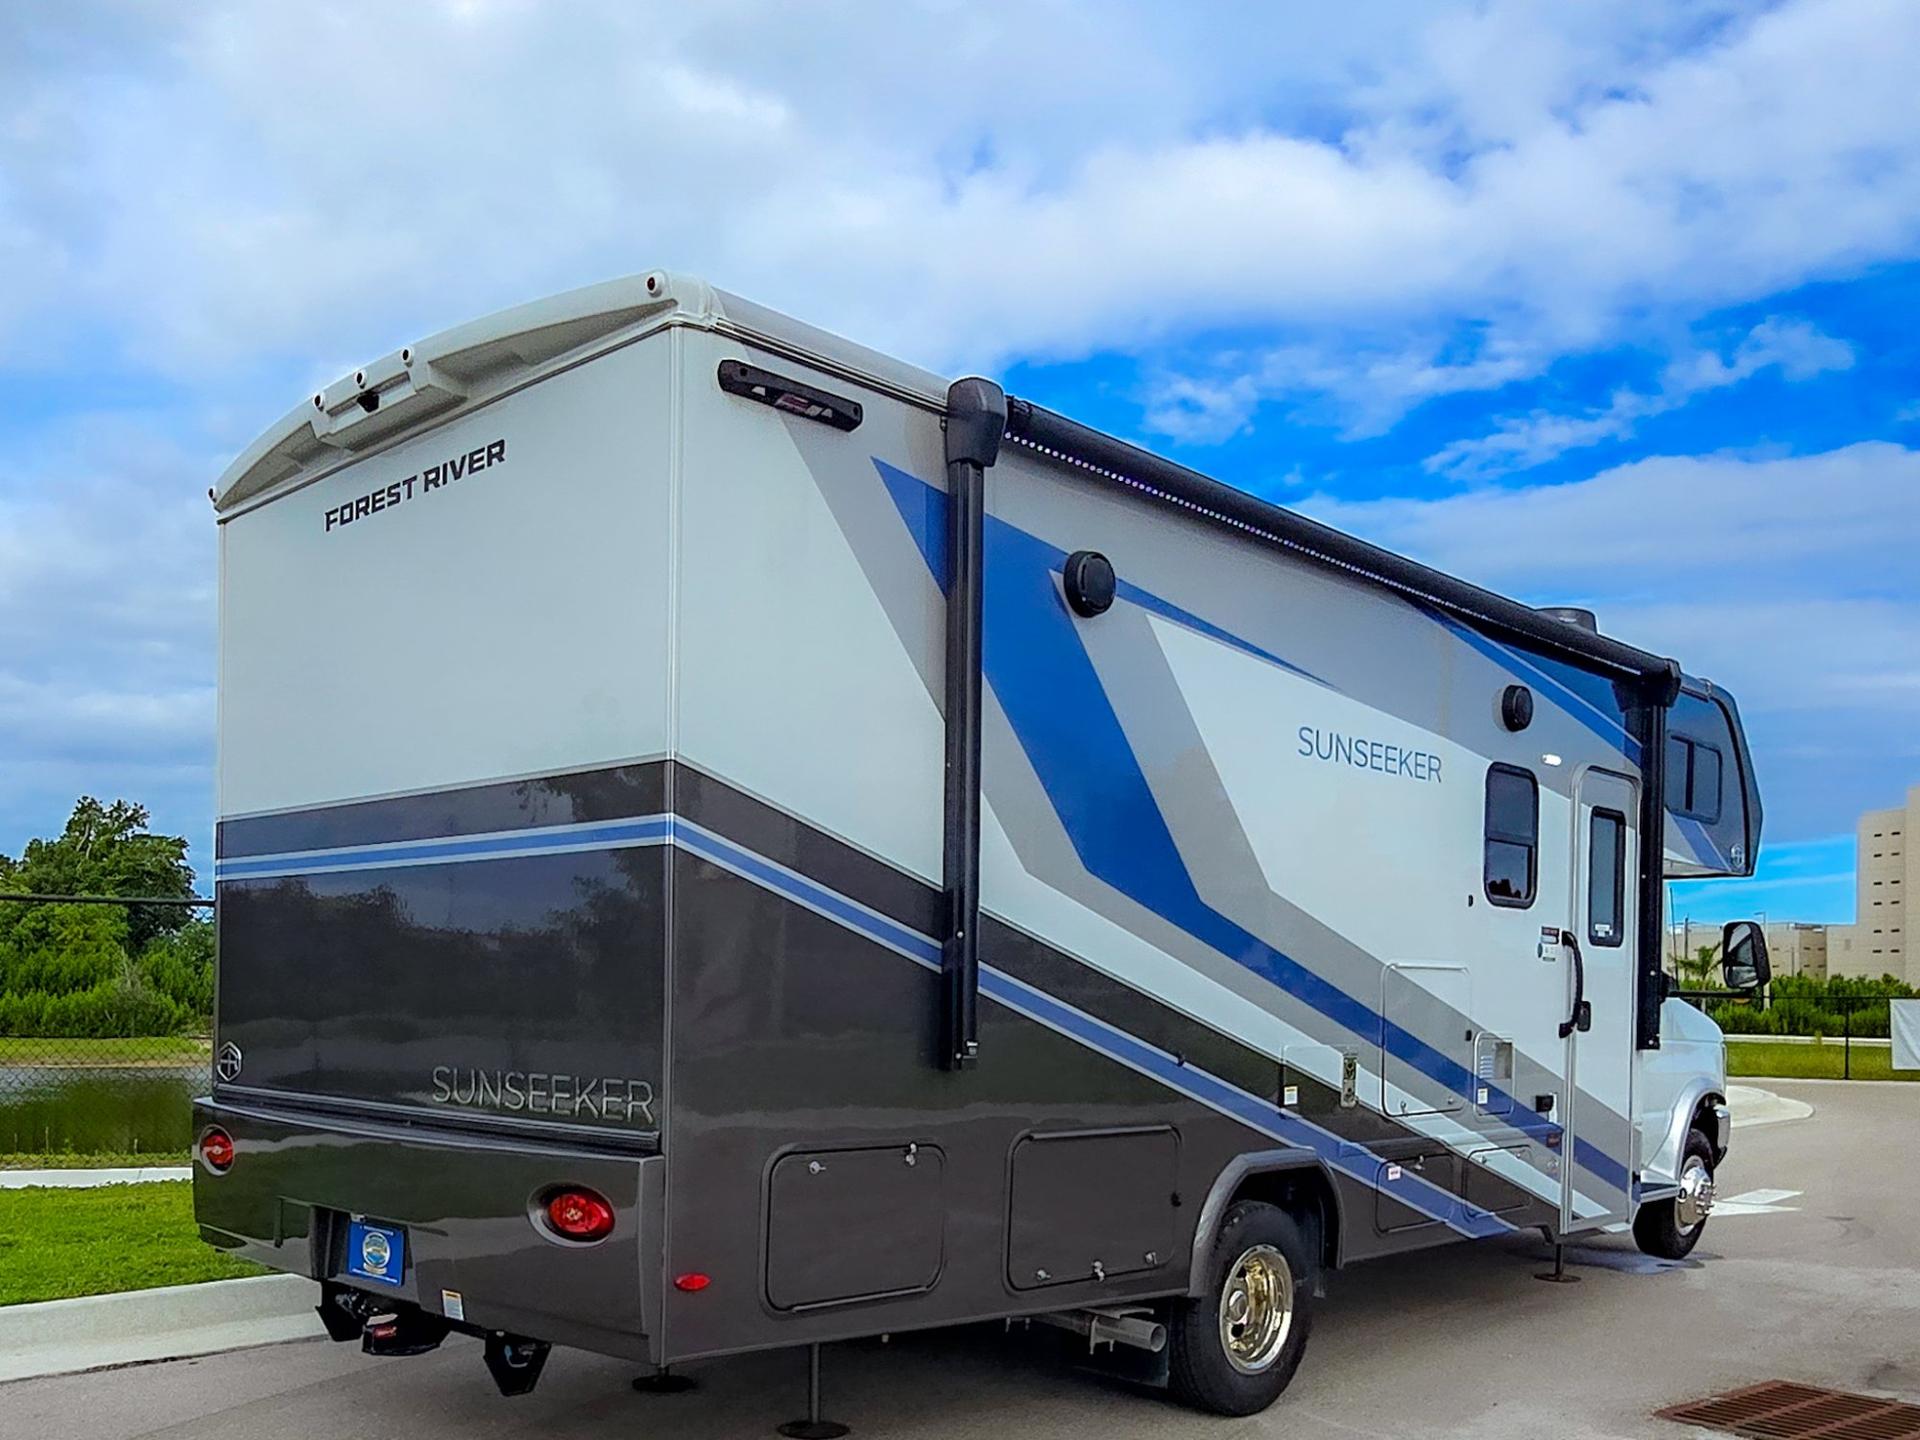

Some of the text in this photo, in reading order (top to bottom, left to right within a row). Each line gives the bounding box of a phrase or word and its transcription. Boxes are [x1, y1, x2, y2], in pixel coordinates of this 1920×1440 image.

[324, 438, 506, 532] FOREST RIVER
[1298, 726, 1442, 783] SUNSEEKER
[432, 1065, 654, 1124] SUNSEEKER
